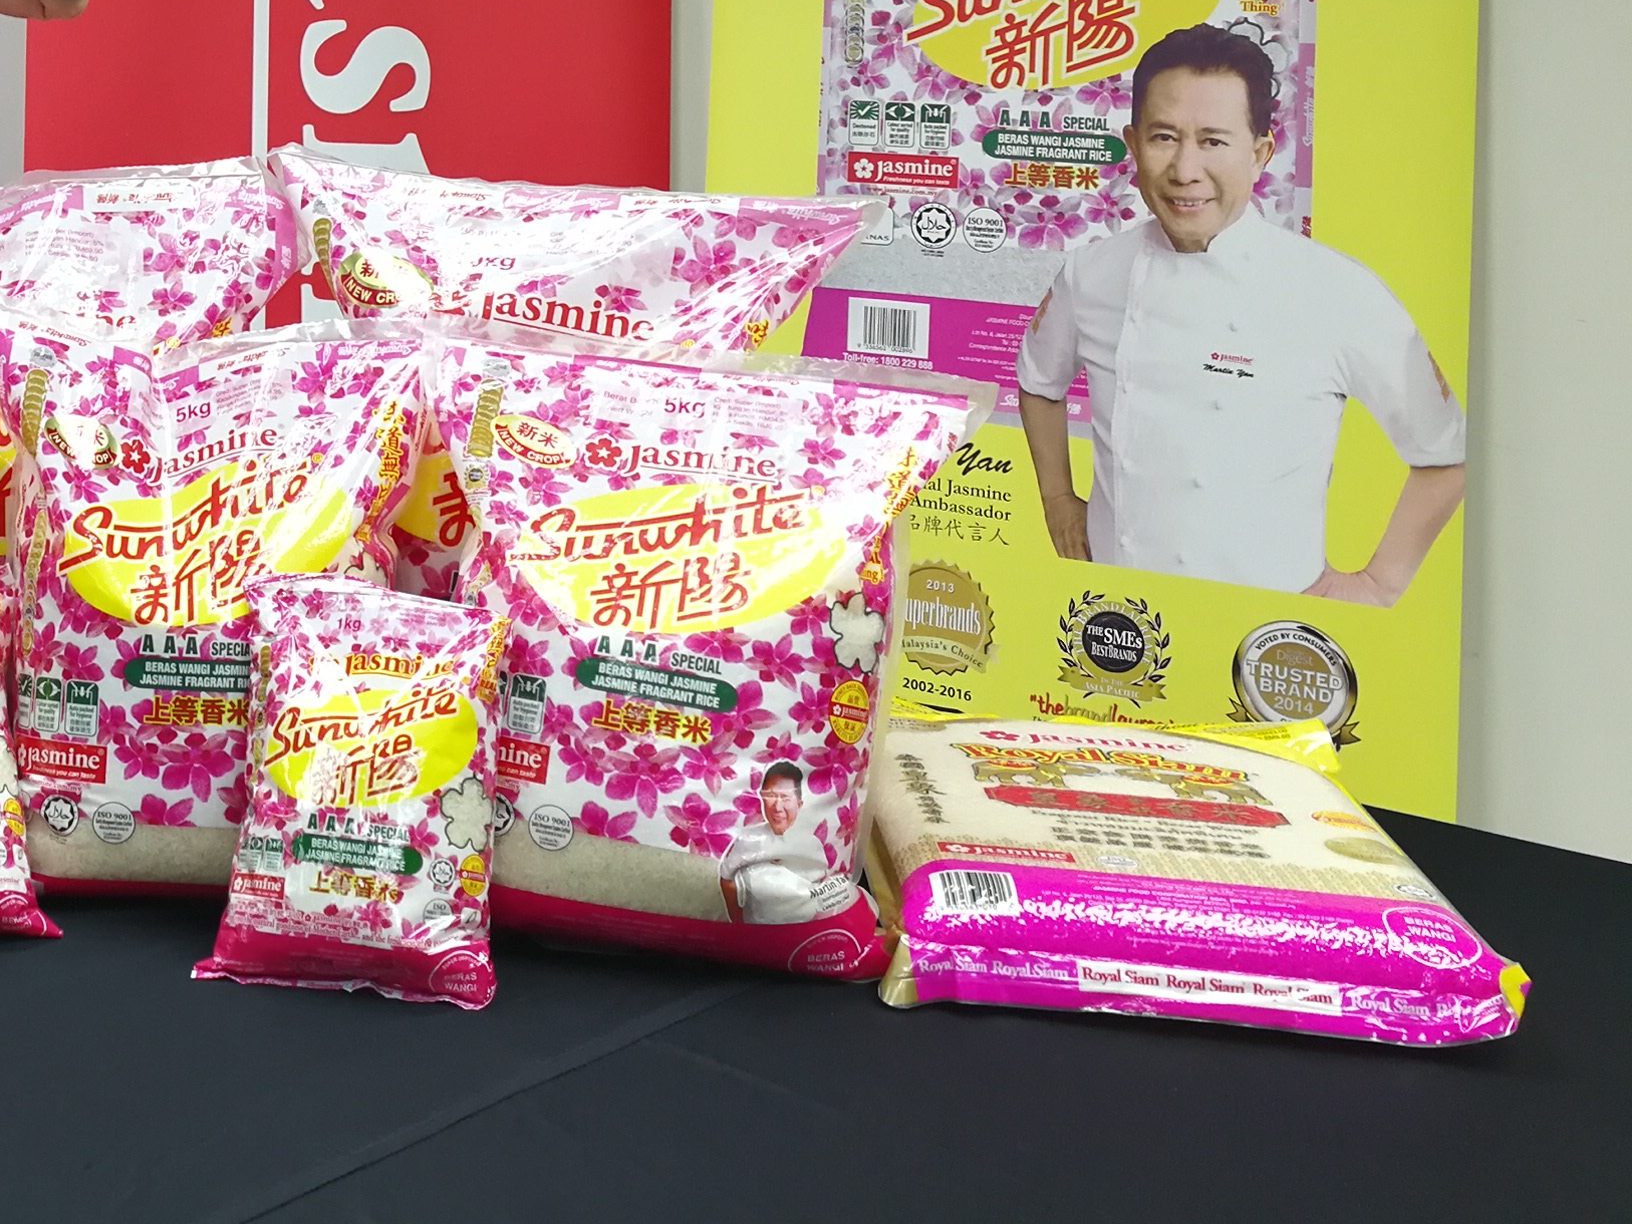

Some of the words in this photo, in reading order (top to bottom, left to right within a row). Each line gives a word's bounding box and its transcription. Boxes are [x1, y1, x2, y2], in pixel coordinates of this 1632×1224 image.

[1240, 0, 1278, 15] Thing
[999, 109, 1011, 126] A
[1019, 110, 1031, 127] A
[1039, 111, 1051, 128] A
[1063, 116, 1110, 131] SPECIAL
[998, 133, 1029, 145] BERAS
[1030, 135, 1062, 147] WANGI
[1062, 137, 1105, 149] JASMINE
[995, 145, 1034, 157] JASMINE
[1036, 147, 1088, 160] FRAGRANT
[1089, 150, 1112, 161] RICE
[876, 158, 954, 182] Jasmine
[1005, 162, 1100, 190] 上等香米
[968, 217, 983, 226] ISO
[984, 218, 1004, 227] 9001
[347, 277, 371, 302] NEW
[843, 352, 879, 364] Toll-free:
[880, 356, 900, 367] 1800
[901, 358, 917, 368] 229
[918, 359, 933, 370] 888
[175, 401, 212, 423] 5kg
[664, 396, 705, 418] 5kg
[499, 429, 525, 455] NEW
[516, 421, 560, 450] 新米
[624, 444, 776, 475] Jasmine
[955, 441, 1013, 476] Yan
[945, 479, 1012, 503] Jasmine
[910, 494, 1012, 521] Ambassador
[509, 484, 806, 562] Sunwhite
[590, 552, 752, 629] 新陽
[926, 579, 955, 593] 2013
[336, 617, 361, 631] 1kg
[905, 597, 981, 636] uperbrands
[1086, 624, 1104, 637] THE
[1103, 628, 1143, 649] SMEs
[211, 642, 251, 656] SPECIA
[950, 644, 984, 668] Choice
[1255, 633, 1279, 651] VOTED
[1280, 632, 1291, 640] BY
[1292, 633, 1337, 666] CONSUMERS
[1276, 649, 1314, 666] Digest
[145, 661, 176, 673] BERAS
[178, 662, 210, 675] WANGI
[212, 663, 251, 676] JASMIN
[671, 652, 722, 675] SPECIAL
[140, 674, 182, 686] JASMINE
[185, 676, 235, 688] FRAGRANT
[598, 662, 633, 678] BERAS
[634, 669, 668, 685] WANGI
[670, 677, 718, 694] JASMINE
[1246, 660, 1344, 691] TRUSTED
[591, 675, 638, 692] JASMINE
[639, 684, 694, 703] FRAGRANT
[696, 695, 720, 708] RICE
[902, 677, 972, 701] 2002-2016
[1259, 677, 1332, 703] BRAND
[145, 694, 250, 726] 上等香米
[1274, 696, 1314, 714] 2014
[593, 699, 712, 744] 上等香米
[1029, 733, 1186, 753] Jasmine
[27, 746, 101, 770] Jasmine
[953, 742, 1109, 766] Royal
[1112, 751, 1248, 781] Siam
[98, 811, 112, 820] ISO
[113, 812, 132, 821] 9001
[534, 813, 549, 823] ISO
[366, 823, 409, 842] SPECIAL
[305, 848, 340, 863] JASMINE
[311, 837, 338, 850] BERAS
[339, 840, 366, 853] WANGI
[972, 845, 1068, 861] Jasmine
[1404, 916, 1453, 933] BERAS
[1407, 926, 1456, 944] WANGI
[955, 959, 987, 973] Siam
[992, 960, 1032, 978] Royal
[1033, 963, 1068, 979] Siam
[1082, 966, 1121, 984] Royal
[1125, 969, 1159, 986] Siam
[1167, 974, 1206, 992] Royal
[1209, 979, 1244, 994] Siam
[1351, 994, 1393, 1013] Royal
[1394, 997, 1429, 1017] Siam
